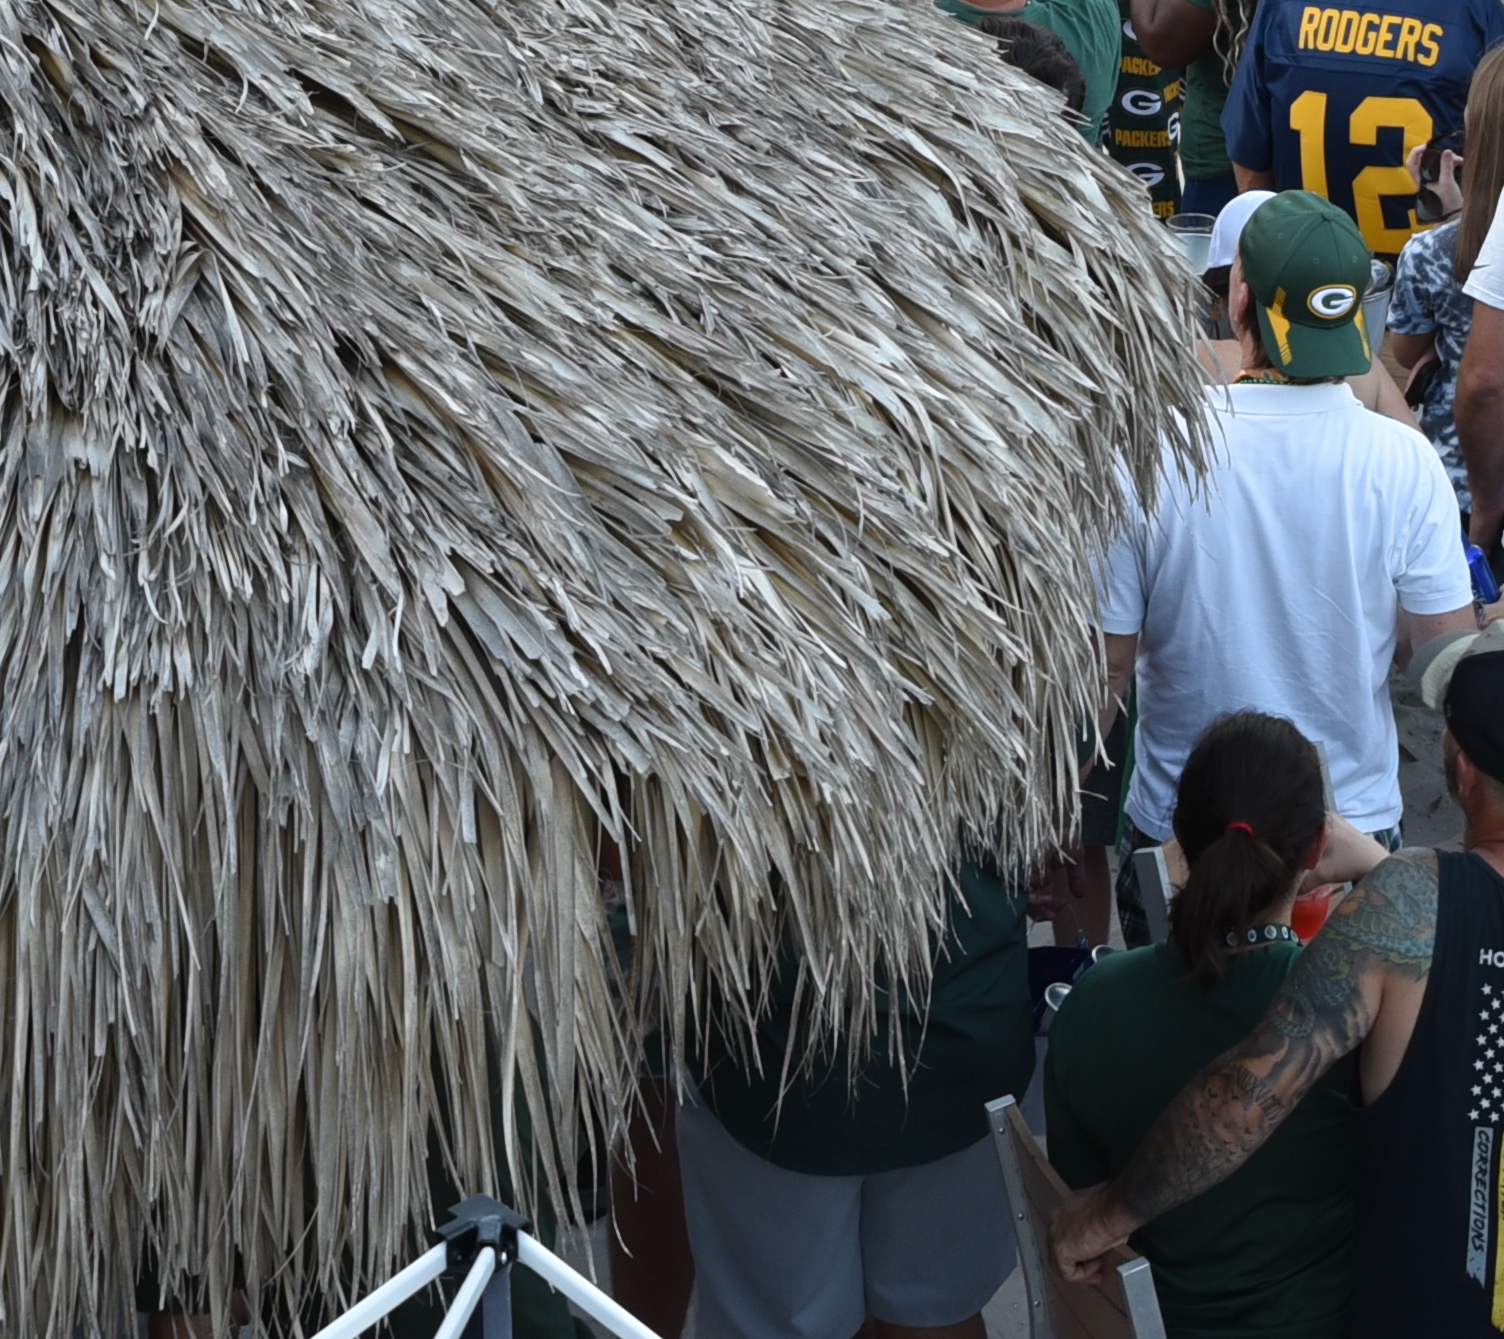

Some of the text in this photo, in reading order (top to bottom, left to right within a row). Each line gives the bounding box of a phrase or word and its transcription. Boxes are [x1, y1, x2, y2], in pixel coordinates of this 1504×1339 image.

[1297, 5, 1444, 67] RODGERS
[1289, 89, 1434, 255] 12
[1471, 1128, 1491, 1253] CORRECTIONS
